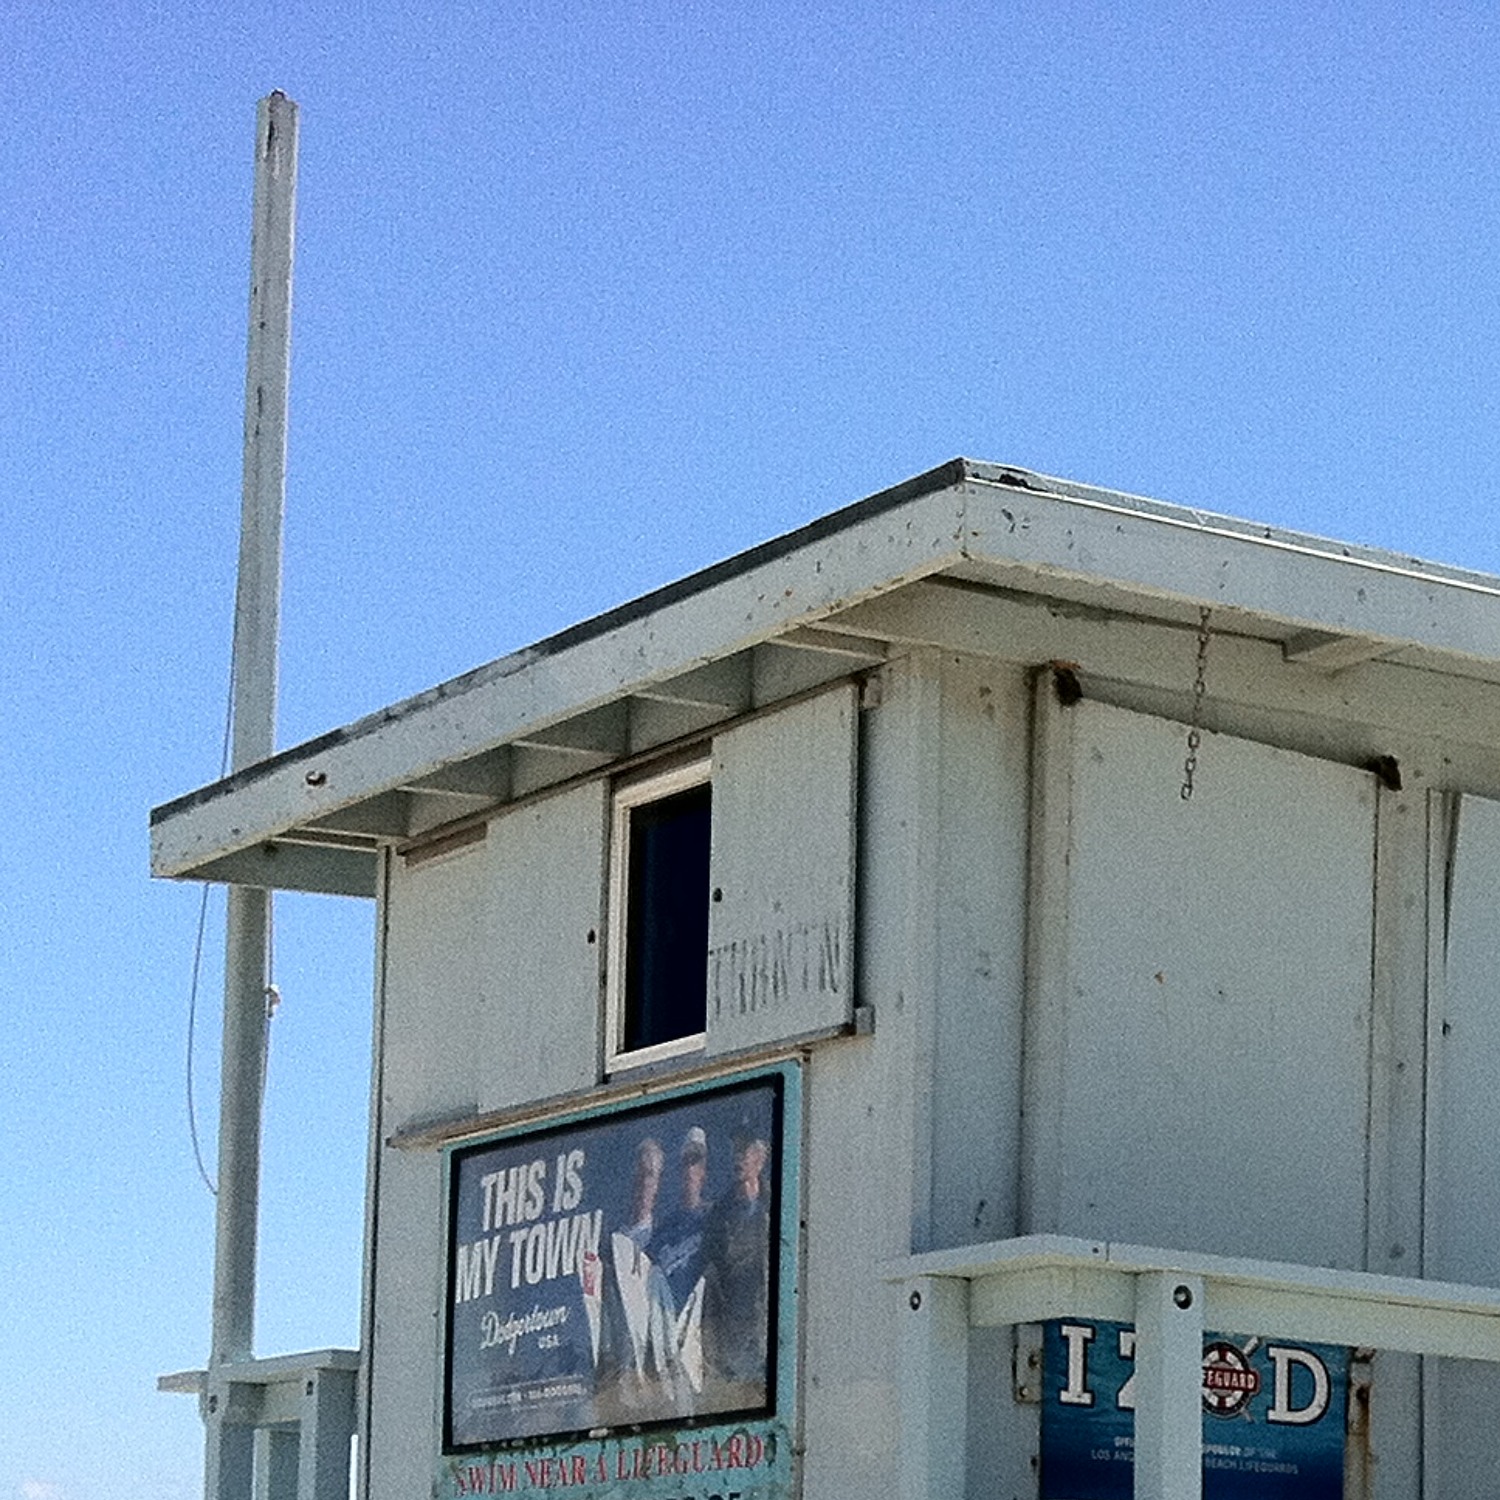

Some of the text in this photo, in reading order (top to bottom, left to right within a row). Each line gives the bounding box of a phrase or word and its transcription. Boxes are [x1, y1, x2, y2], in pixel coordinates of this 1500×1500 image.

[482, 1150, 585, 1232] THIS IS
[455, 1235, 500, 1303] MY
[509, 1210, 603, 1289] TOWN
[454, 1434, 765, 1497] SWIM NEAR A LIFEGUARD
